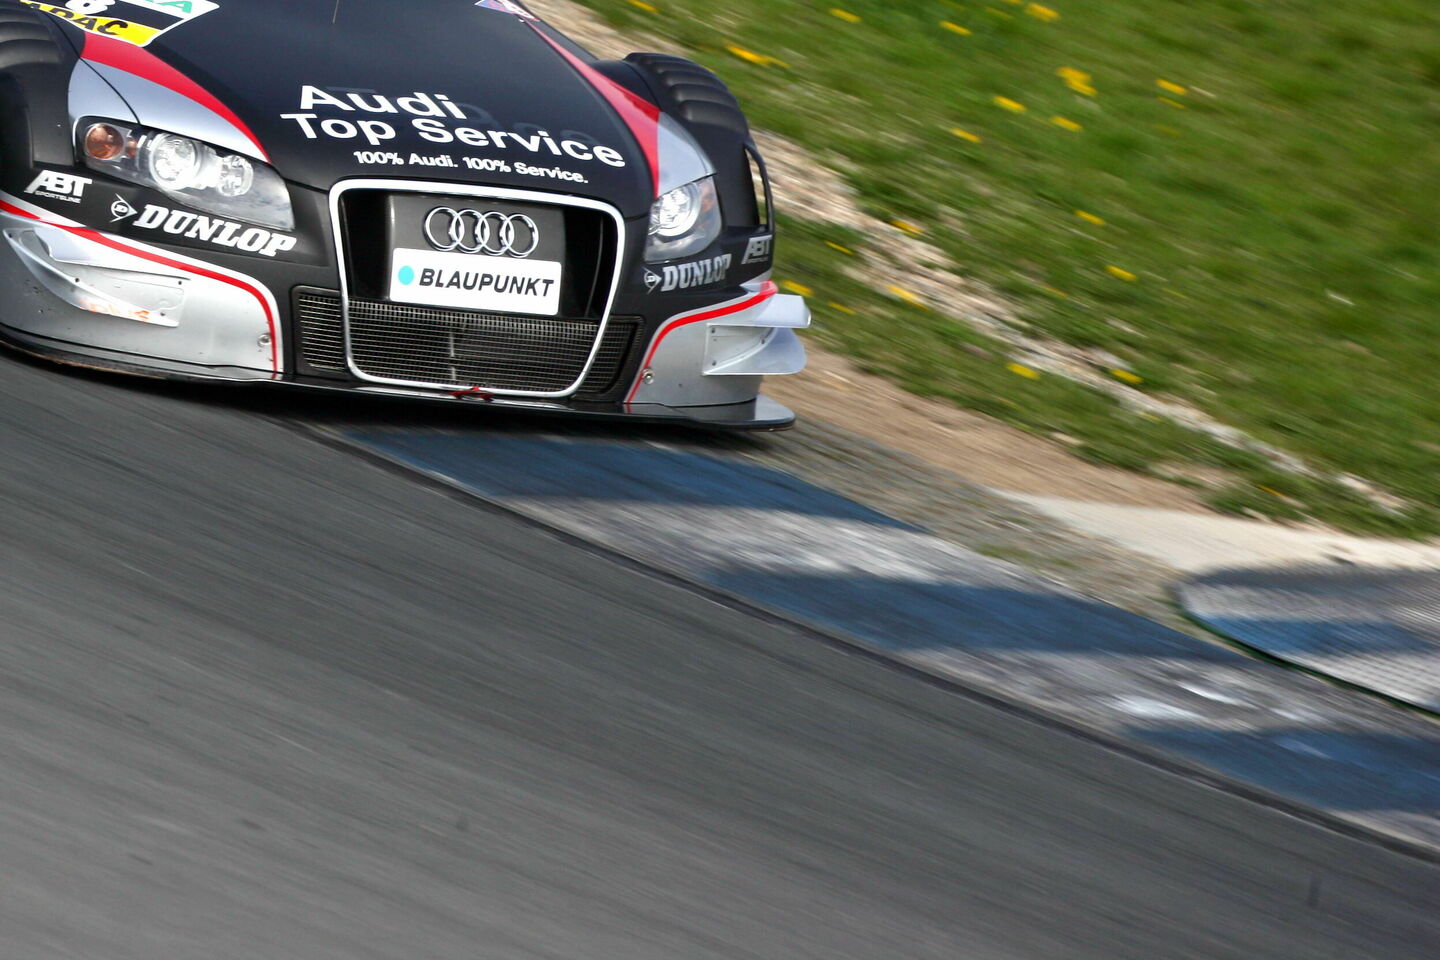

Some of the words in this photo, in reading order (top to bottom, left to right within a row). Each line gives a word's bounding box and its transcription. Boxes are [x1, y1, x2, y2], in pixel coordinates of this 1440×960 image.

[300, 85, 467, 120] Audi
[280, 113, 396, 146] Top
[411, 118, 626, 167] Service
[24, 169, 93, 198] ABT
[353, 151, 404, 165] 100%
[409, 153, 458, 168] Audi.
[462, 156, 511, 173] 100%
[515, 162, 589, 184] Service.
[133, 204, 297, 257] DUNLOP
[741, 234, 773, 265] ABT
[419, 268, 554, 297] BLAUPUNKT
[660, 253, 732, 292] DUNLOP
